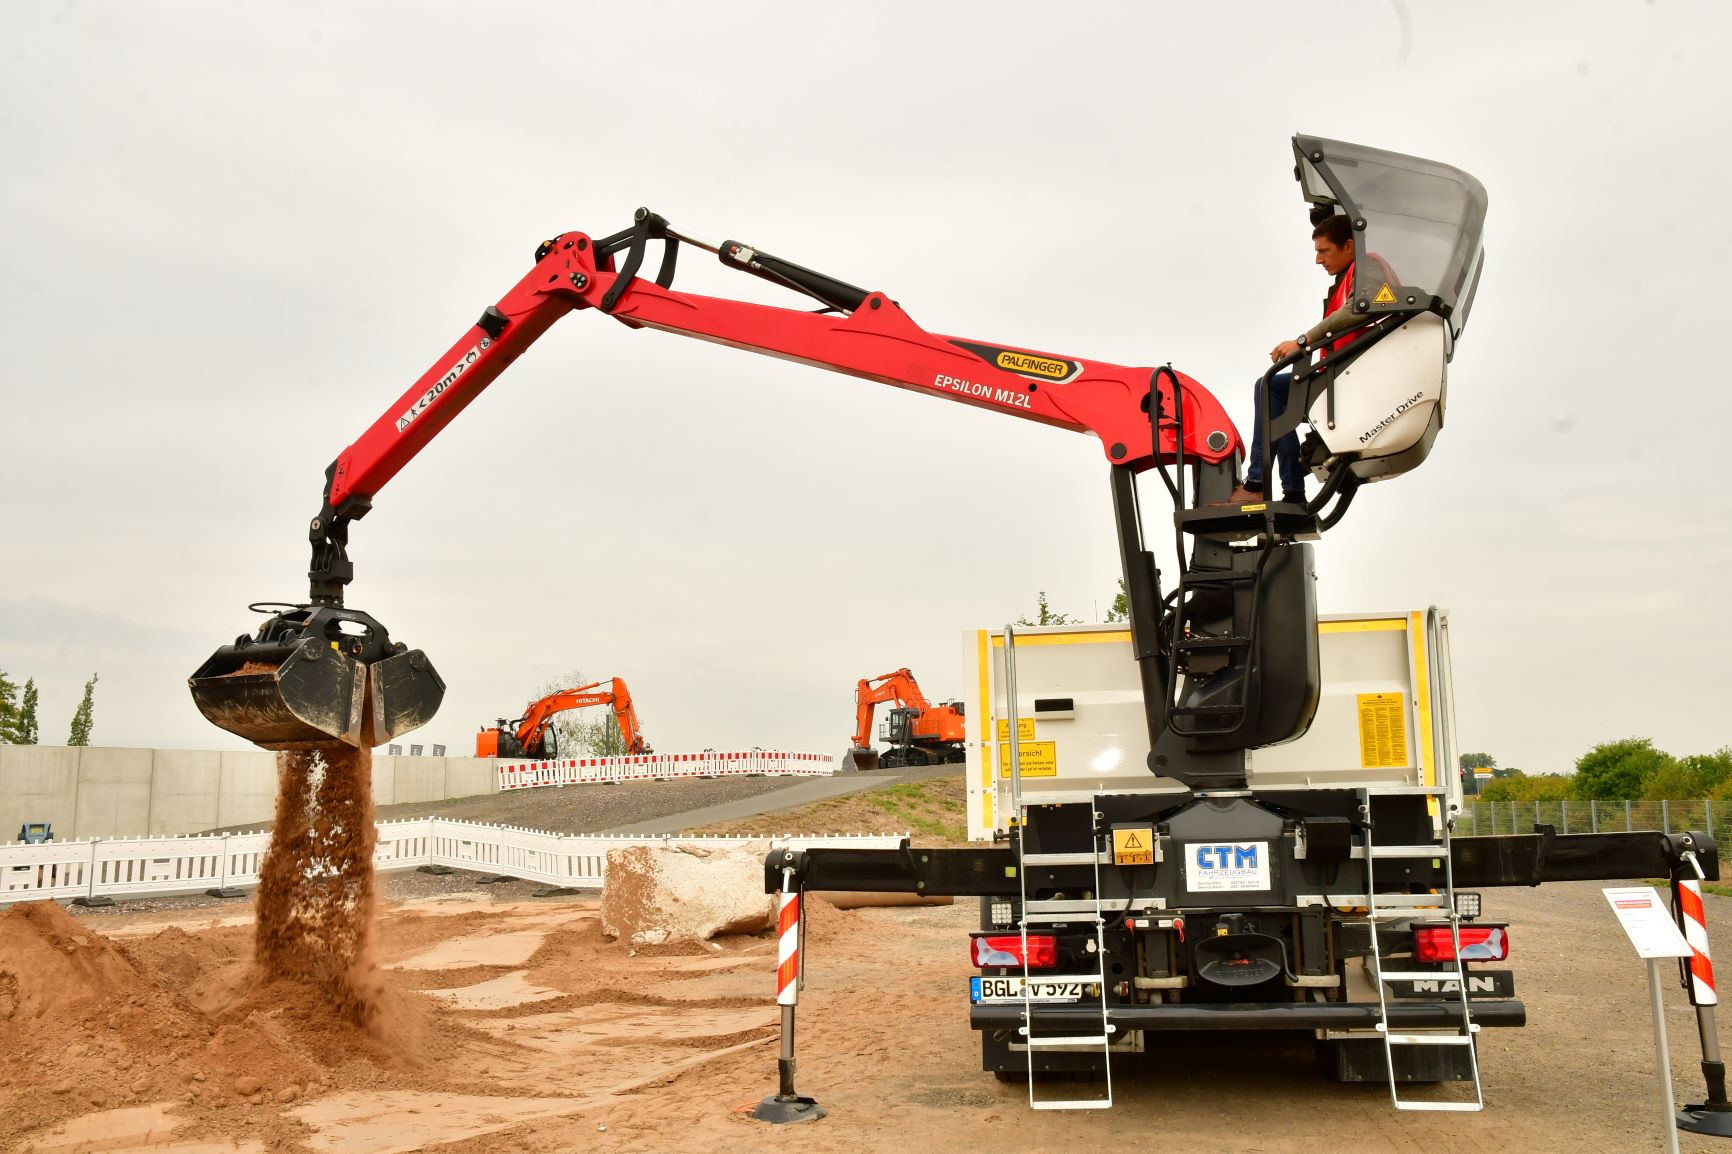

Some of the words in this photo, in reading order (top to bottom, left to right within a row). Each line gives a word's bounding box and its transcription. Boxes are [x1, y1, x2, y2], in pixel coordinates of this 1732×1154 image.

[1001, 354, 1063, 375] PALFINGER
[934, 374, 993, 399] EPSILON
[994, 388, 1032, 409] M12L
[1358, 413, 1396, 444] Master
[1395, 391, 1424, 414] Drive
[1196, 844, 1258, 870] CTM
[982, 980, 1018, 998] BGL
[1046, 983, 1080, 997] 592
[1413, 976, 1495, 993] MAN
